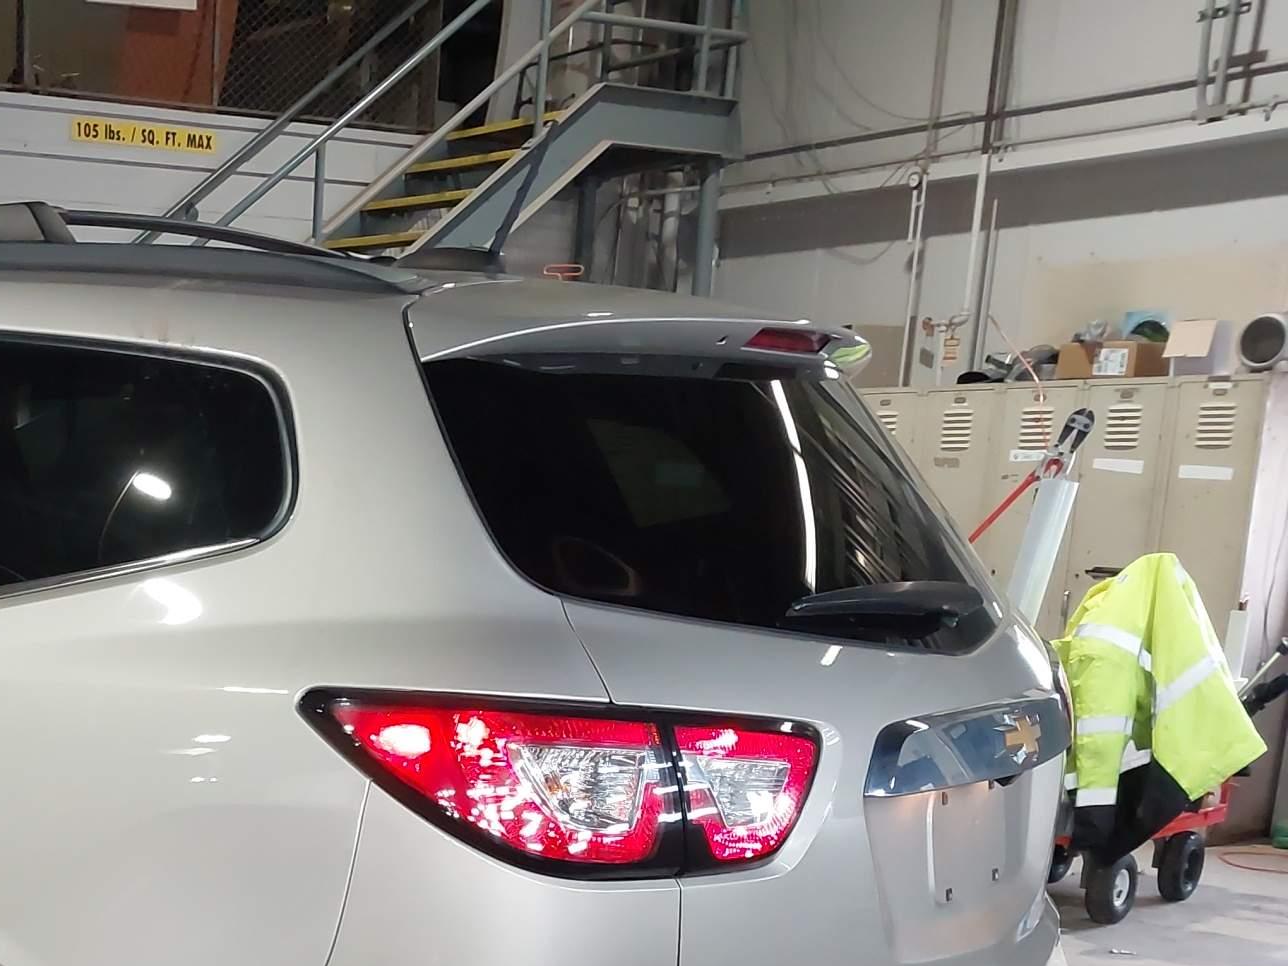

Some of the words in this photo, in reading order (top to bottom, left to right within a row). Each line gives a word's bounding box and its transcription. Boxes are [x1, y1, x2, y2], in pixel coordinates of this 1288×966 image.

[76, 122, 99, 138] 105
[104, 123, 126, 141] lbs.
[131, 127, 137, 142] /
[141, 128, 160, 146] SQ.
[165, 131, 181, 147] FT.
[186, 133, 213, 150] MAX
